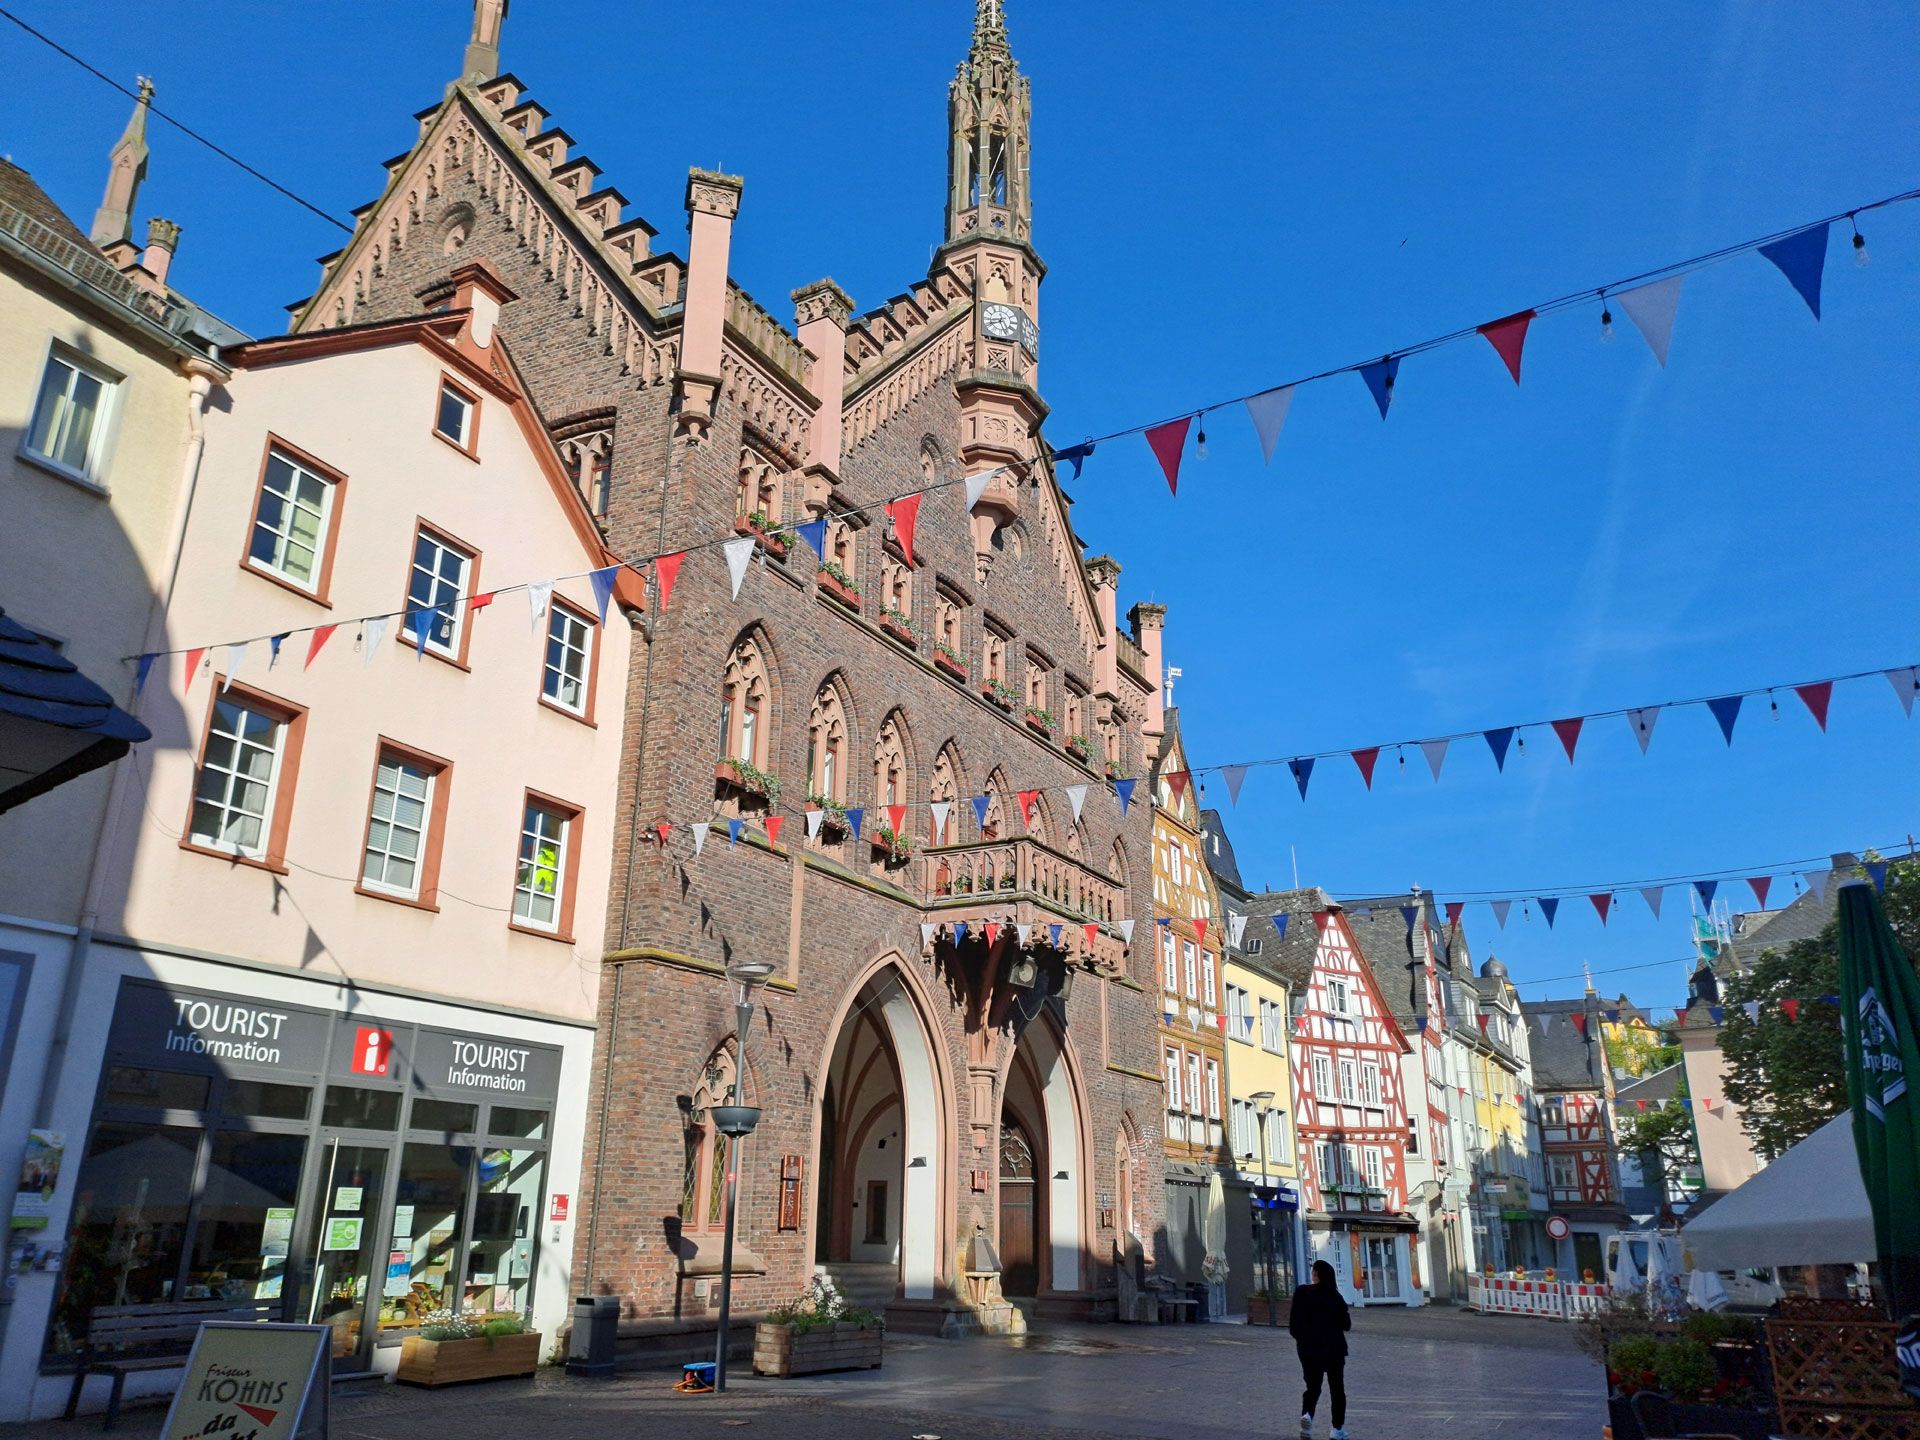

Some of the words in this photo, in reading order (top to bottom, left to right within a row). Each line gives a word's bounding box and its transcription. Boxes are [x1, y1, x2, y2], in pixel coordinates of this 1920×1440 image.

[174, 998, 288, 1040] TOURIST
[165, 1029, 280, 1064] Information
[452, 1040, 530, 1072] TOURIST
[447, 1066, 526, 1092] Information
[206, 1363, 252, 1378] Friseur
[198, 1378, 289, 1405] KOHNS
